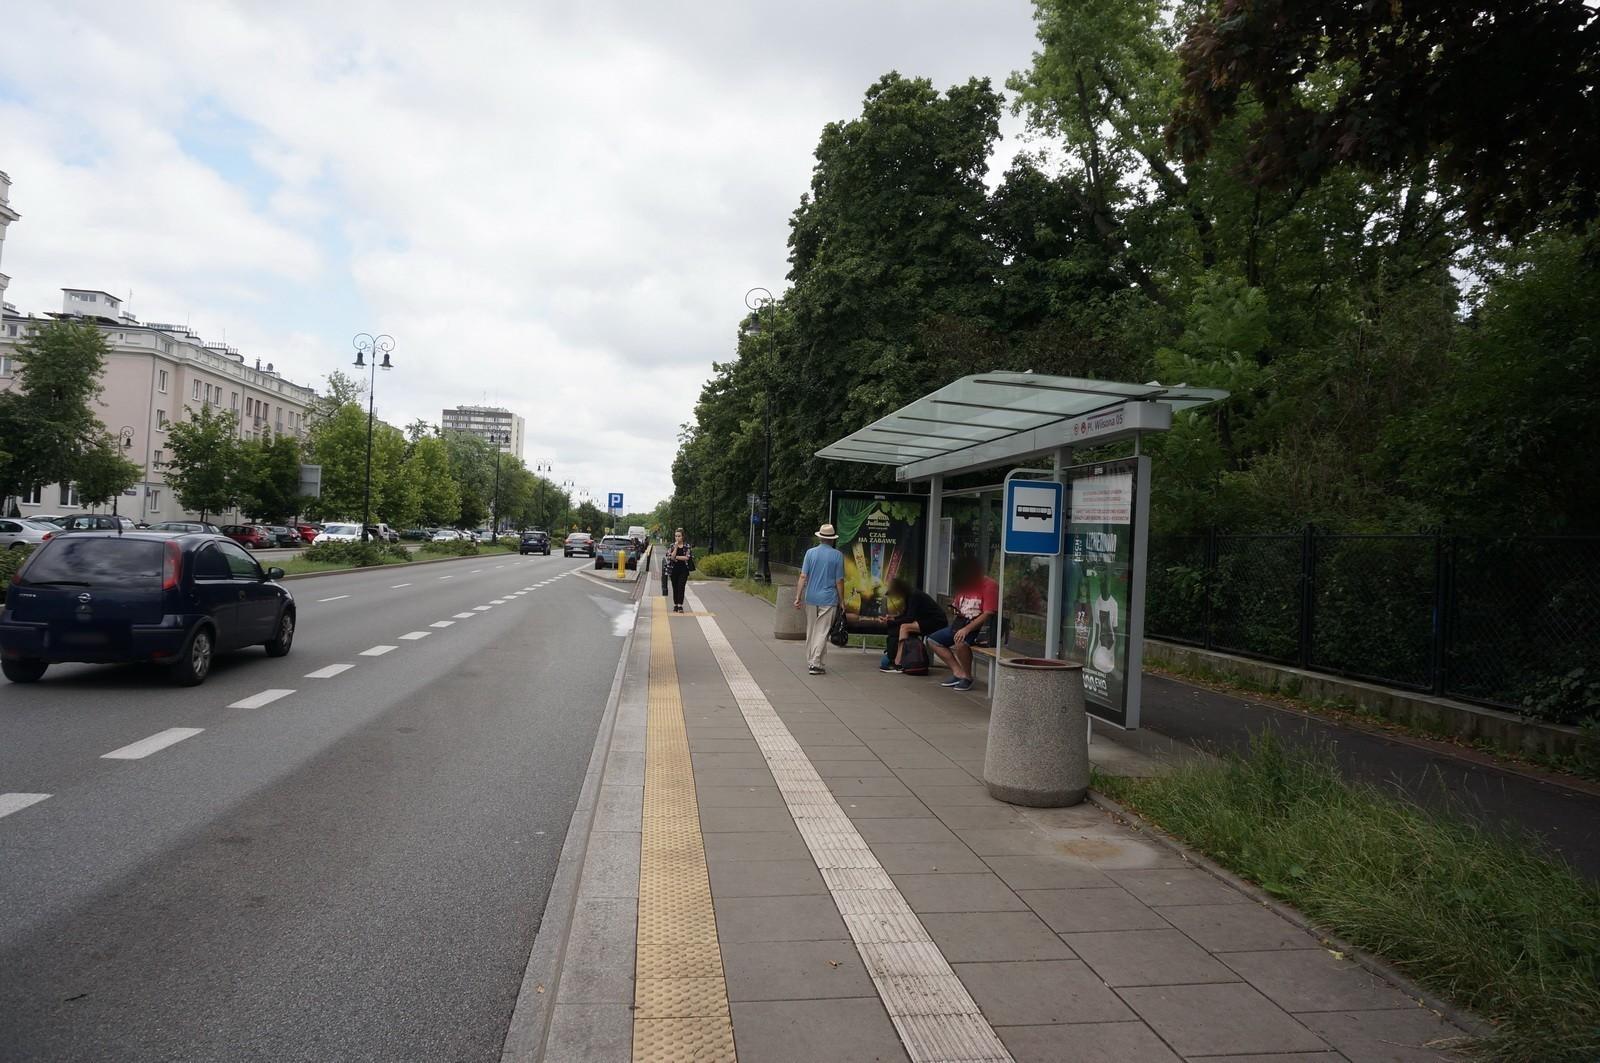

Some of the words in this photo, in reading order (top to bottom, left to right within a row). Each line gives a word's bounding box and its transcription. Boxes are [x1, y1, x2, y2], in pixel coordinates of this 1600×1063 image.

[1095, 417, 1115, 431] Wilsona
[1115, 414, 1123, 425] 05
[611, 494, 621, 507] P
